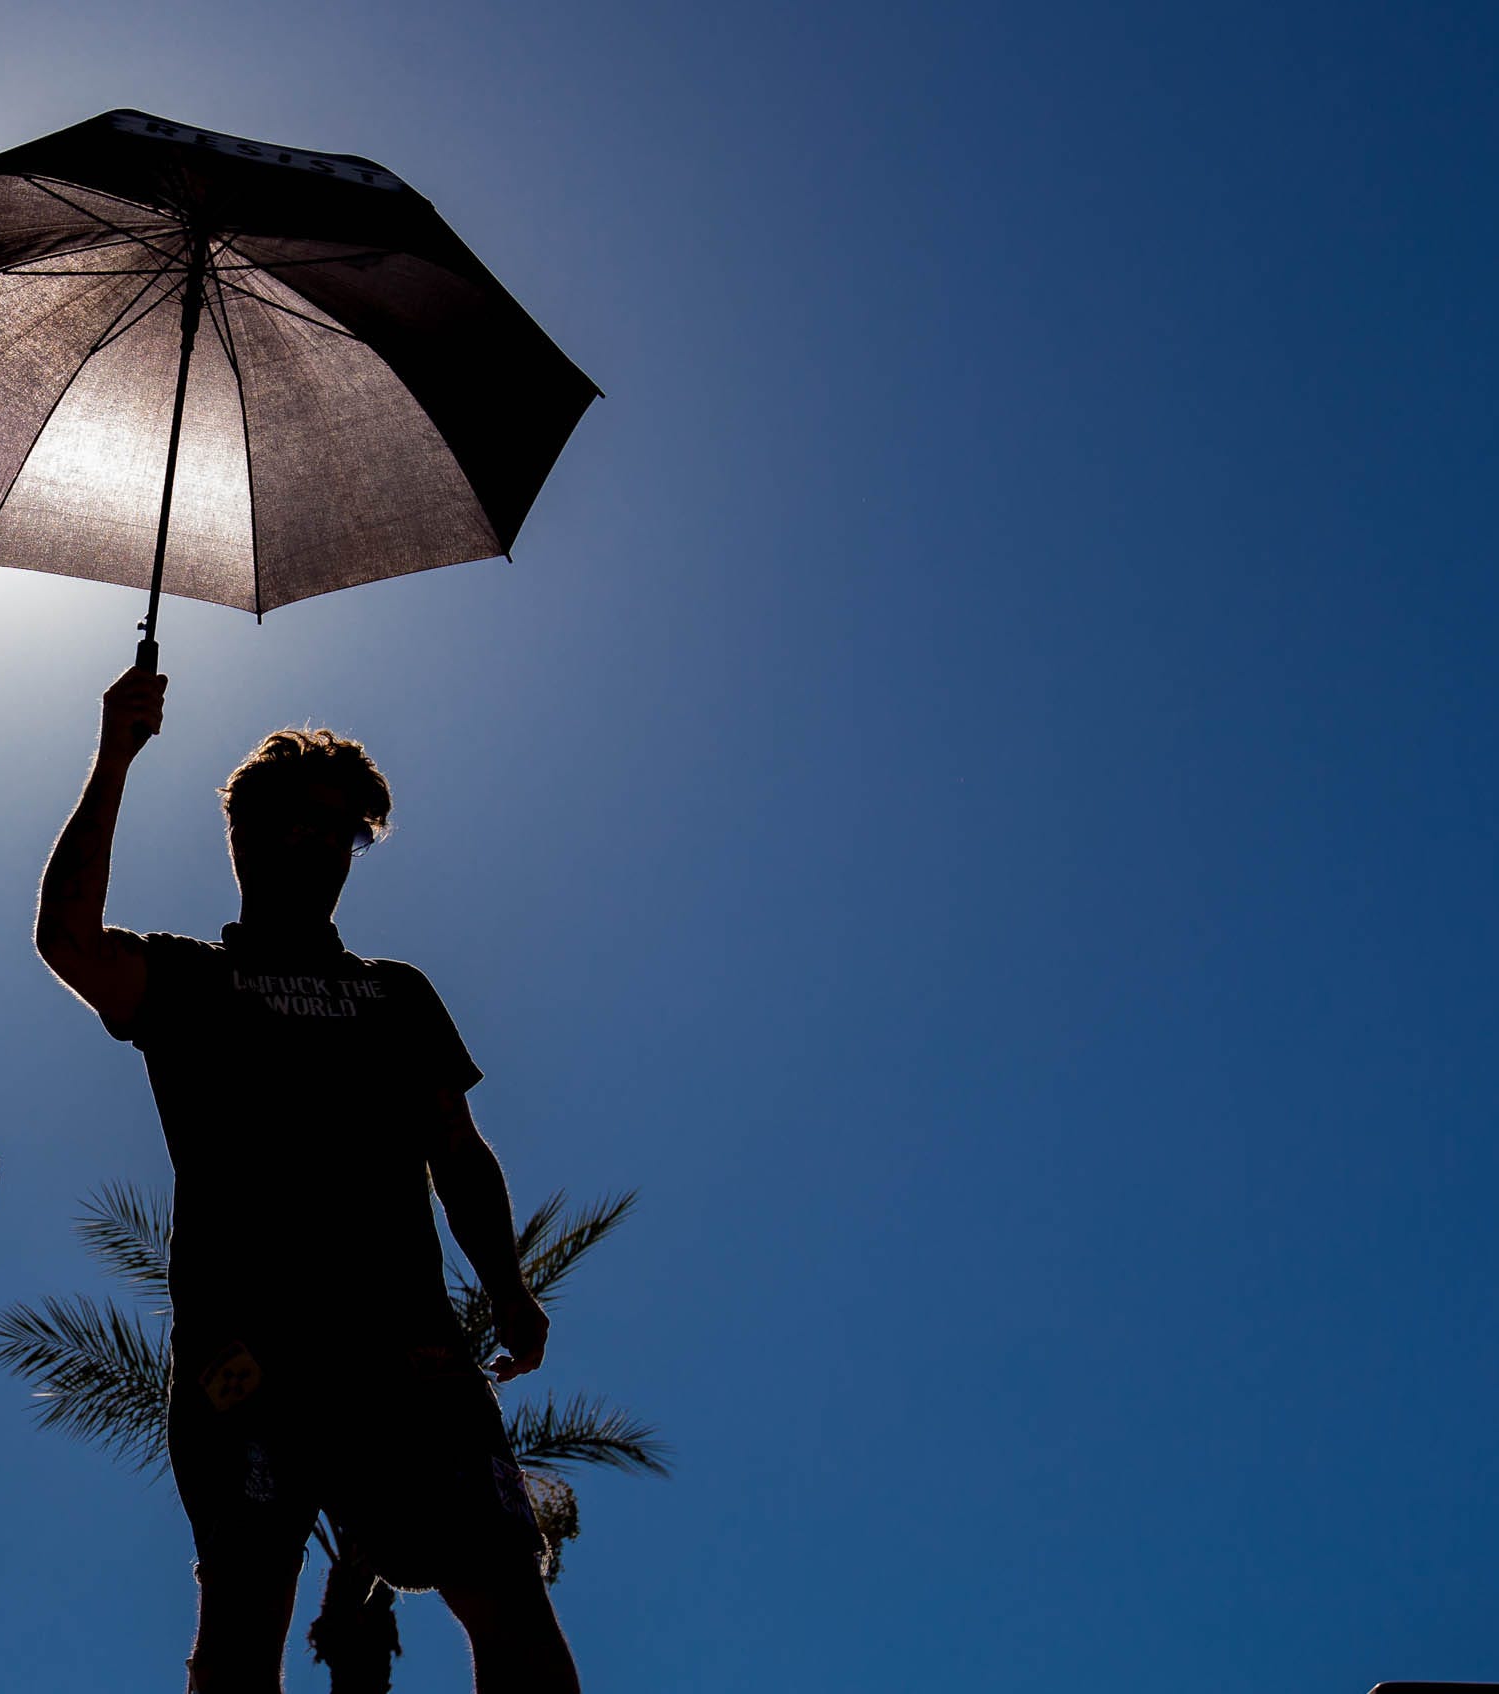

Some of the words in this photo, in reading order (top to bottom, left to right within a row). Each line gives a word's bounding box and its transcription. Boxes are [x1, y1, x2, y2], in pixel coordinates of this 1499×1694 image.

[146, 121, 383, 184] RESIST
[337, 978, 388, 999] THE
[264, 994, 358, 1017] WORLD
